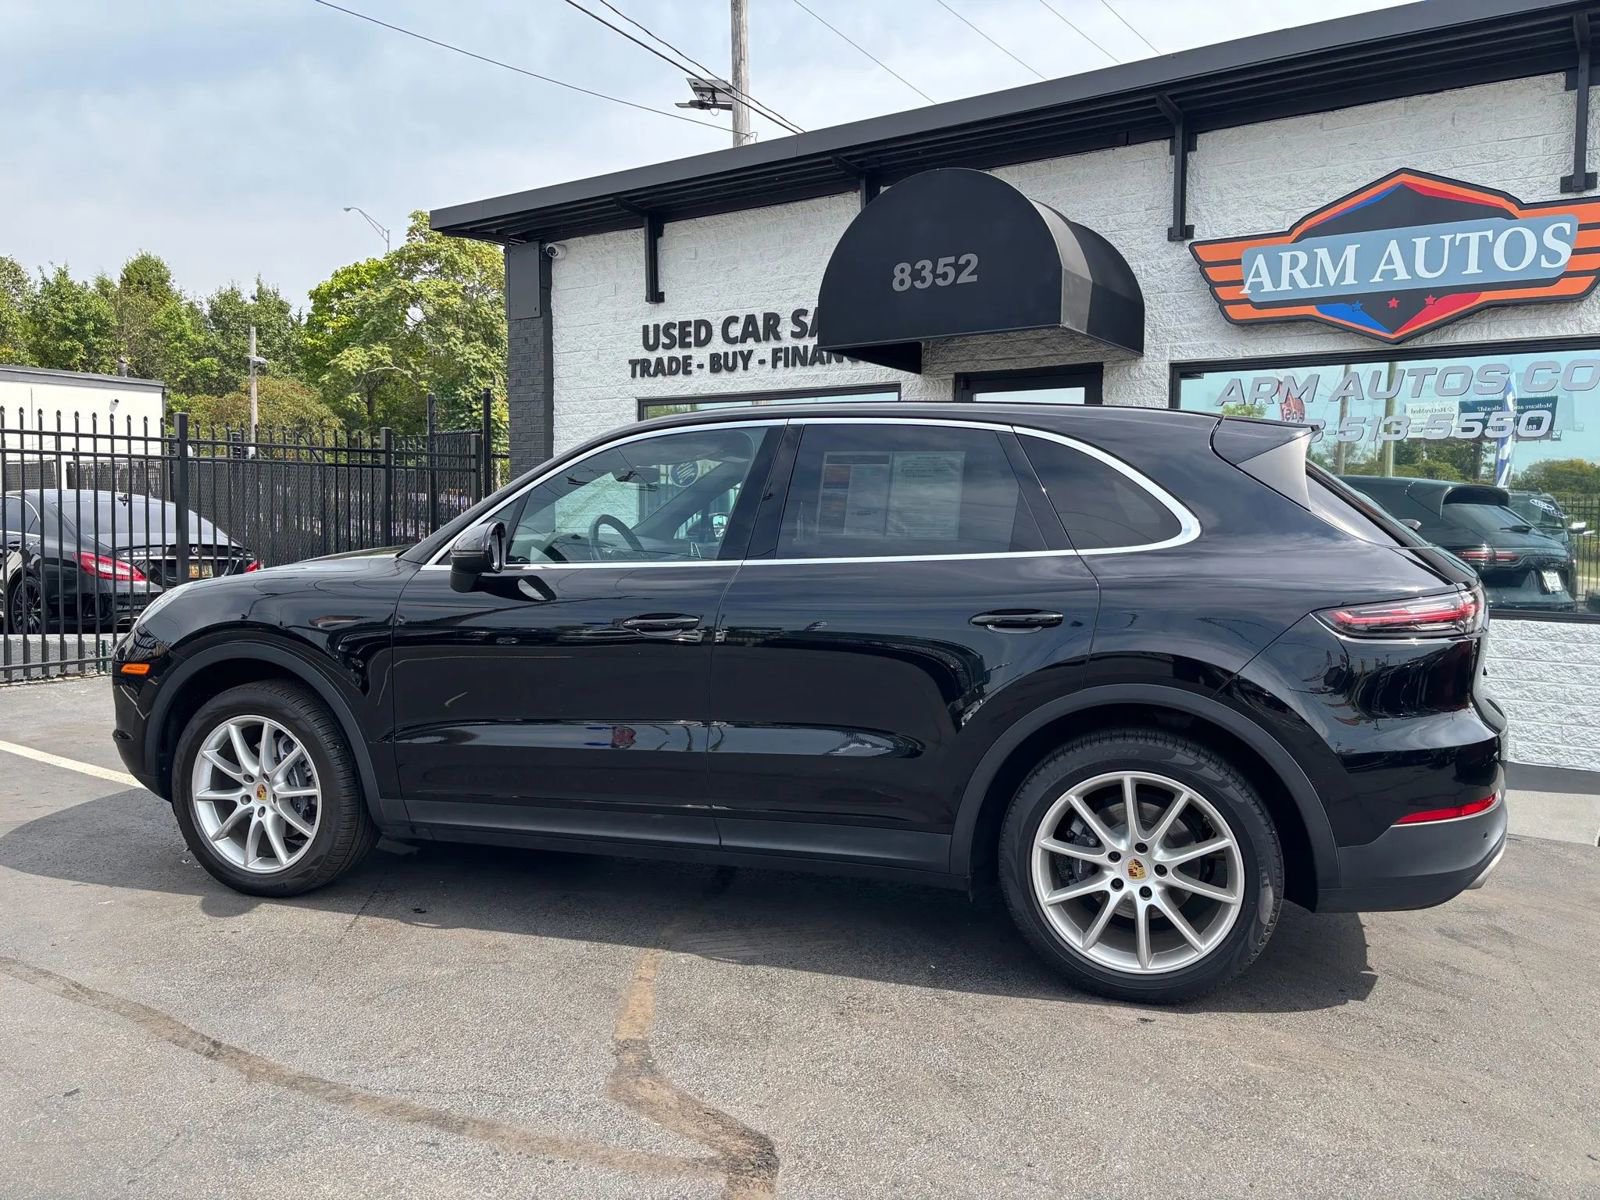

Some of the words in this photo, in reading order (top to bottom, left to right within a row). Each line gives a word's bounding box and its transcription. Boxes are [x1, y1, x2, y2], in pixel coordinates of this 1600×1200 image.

[892, 253, 979, 292] 8352
[1239, 244, 1361, 294] ARM
[1370, 221, 1573, 283] AUTOS
[642, 319, 712, 351] USED
[721, 312, 781, 344] CAR
[628, 354, 693, 378] TRADE
[709, 349, 753, 373] BUY
[771, 345, 859, 369] FINA
[1216, 373, 1320, 406] ARM
[1329, 363, 1510, 401] AUTOS
